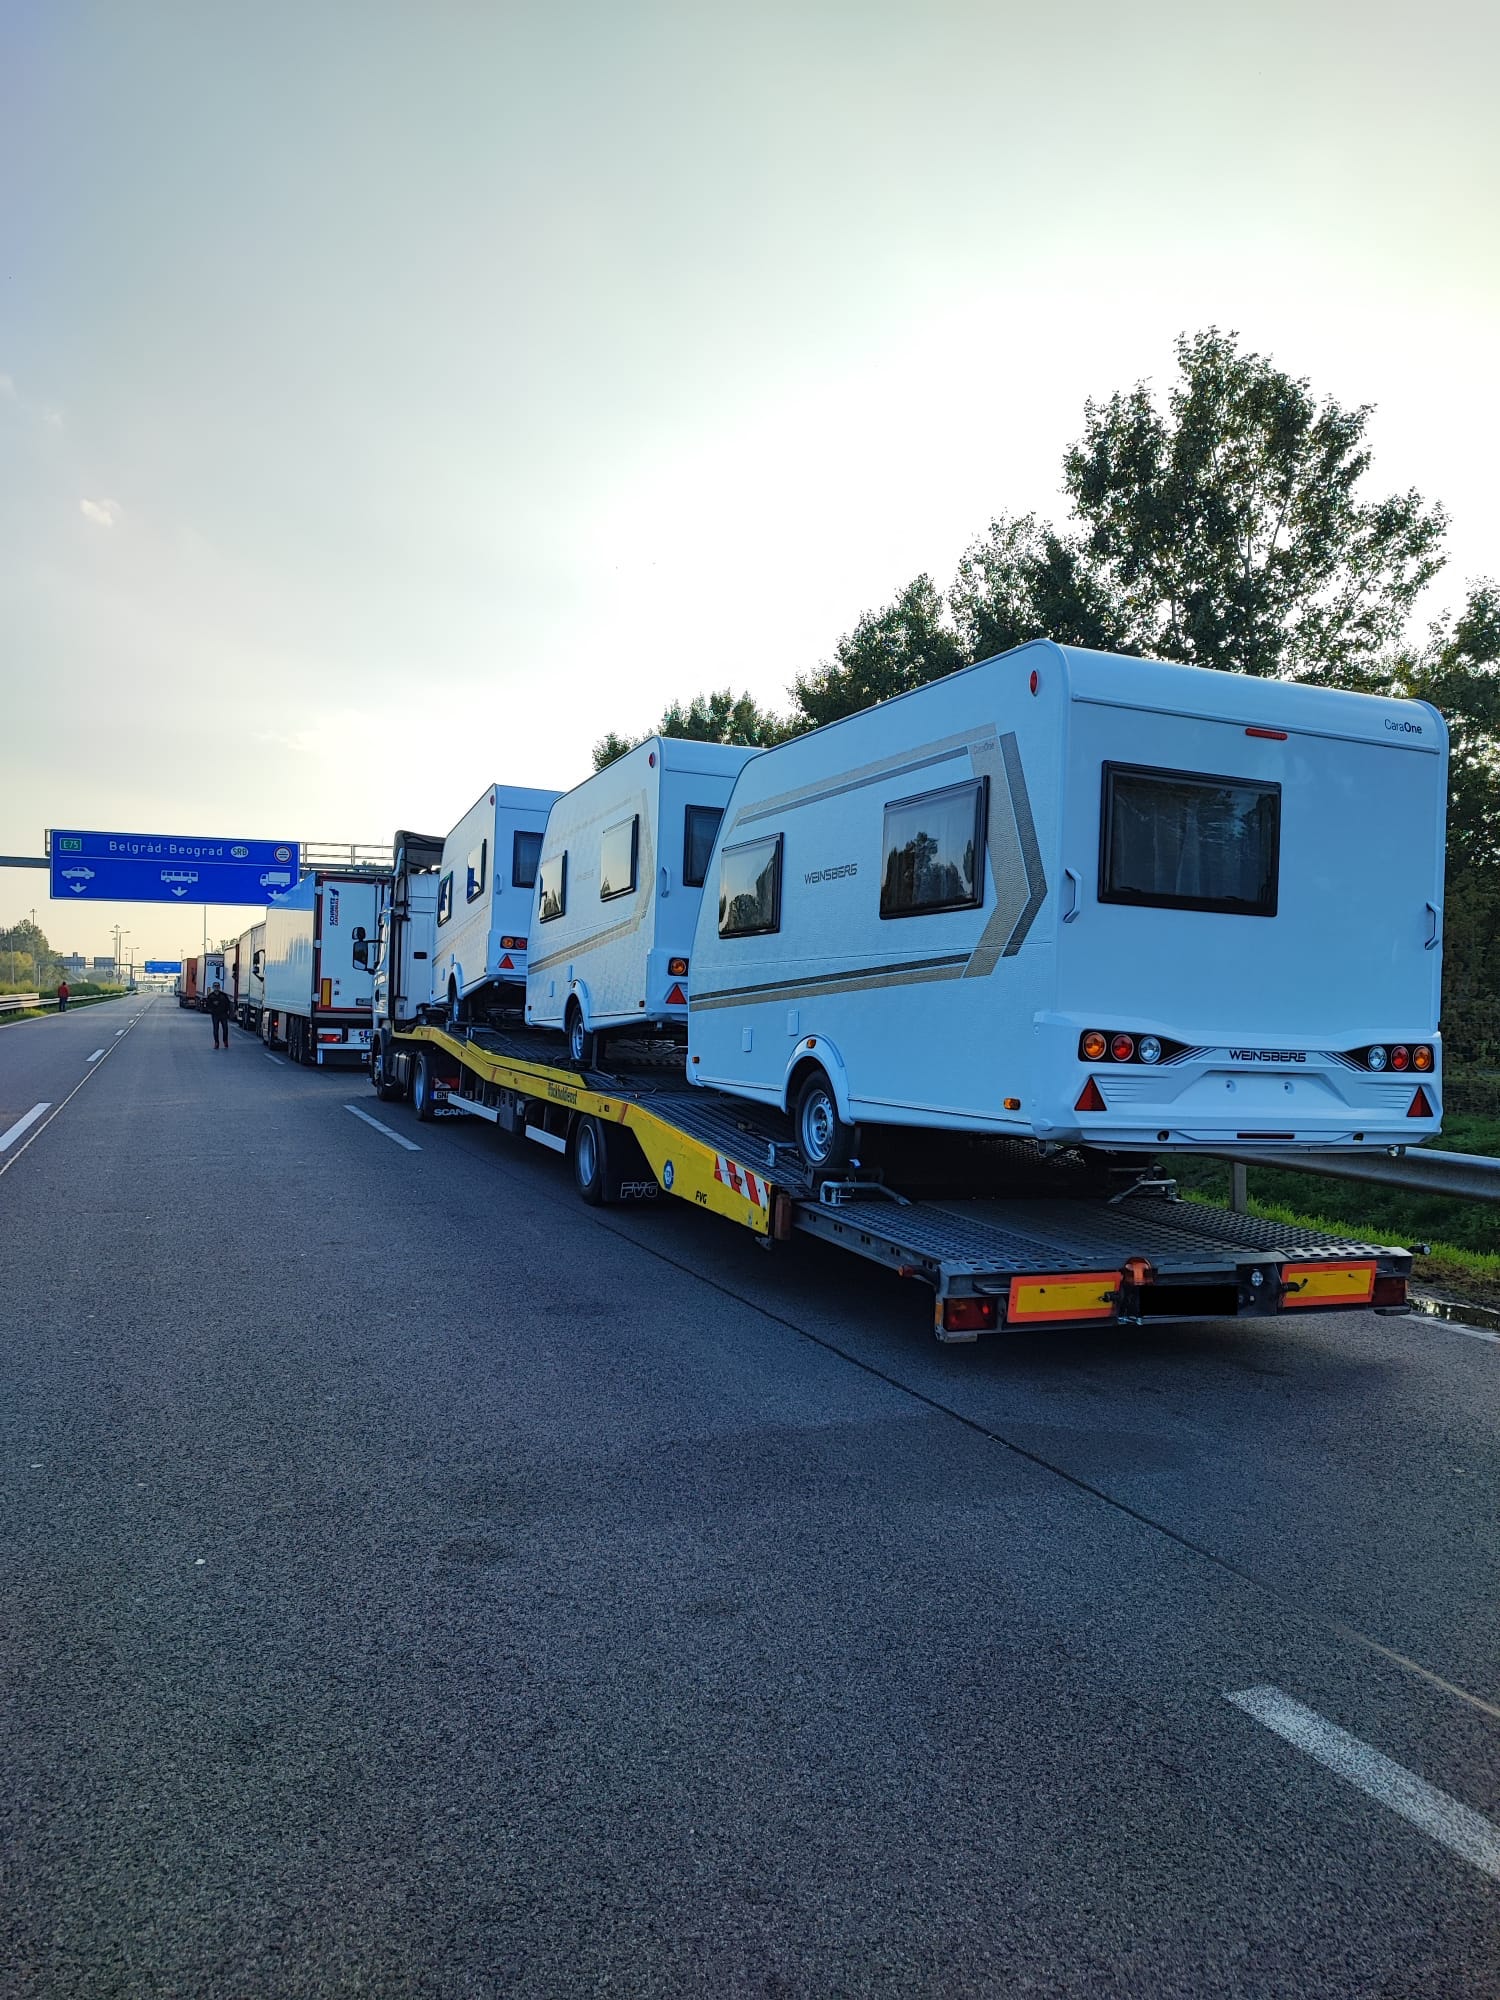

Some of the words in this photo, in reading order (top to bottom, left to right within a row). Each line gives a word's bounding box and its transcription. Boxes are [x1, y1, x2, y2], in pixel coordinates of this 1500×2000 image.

[1384, 718, 1422, 734] CaraOne
[63, 840, 79, 849] E75
[232, 847, 247, 857] SRB
[804, 863, 858, 884] WEINSBERG
[1229, 1049, 1306, 1062] WEINSBERG
[434, 1108, 472, 1116] SCAN
[620, 1182, 658, 1198] FVG
[695, 1190, 708, 1205] FVG
